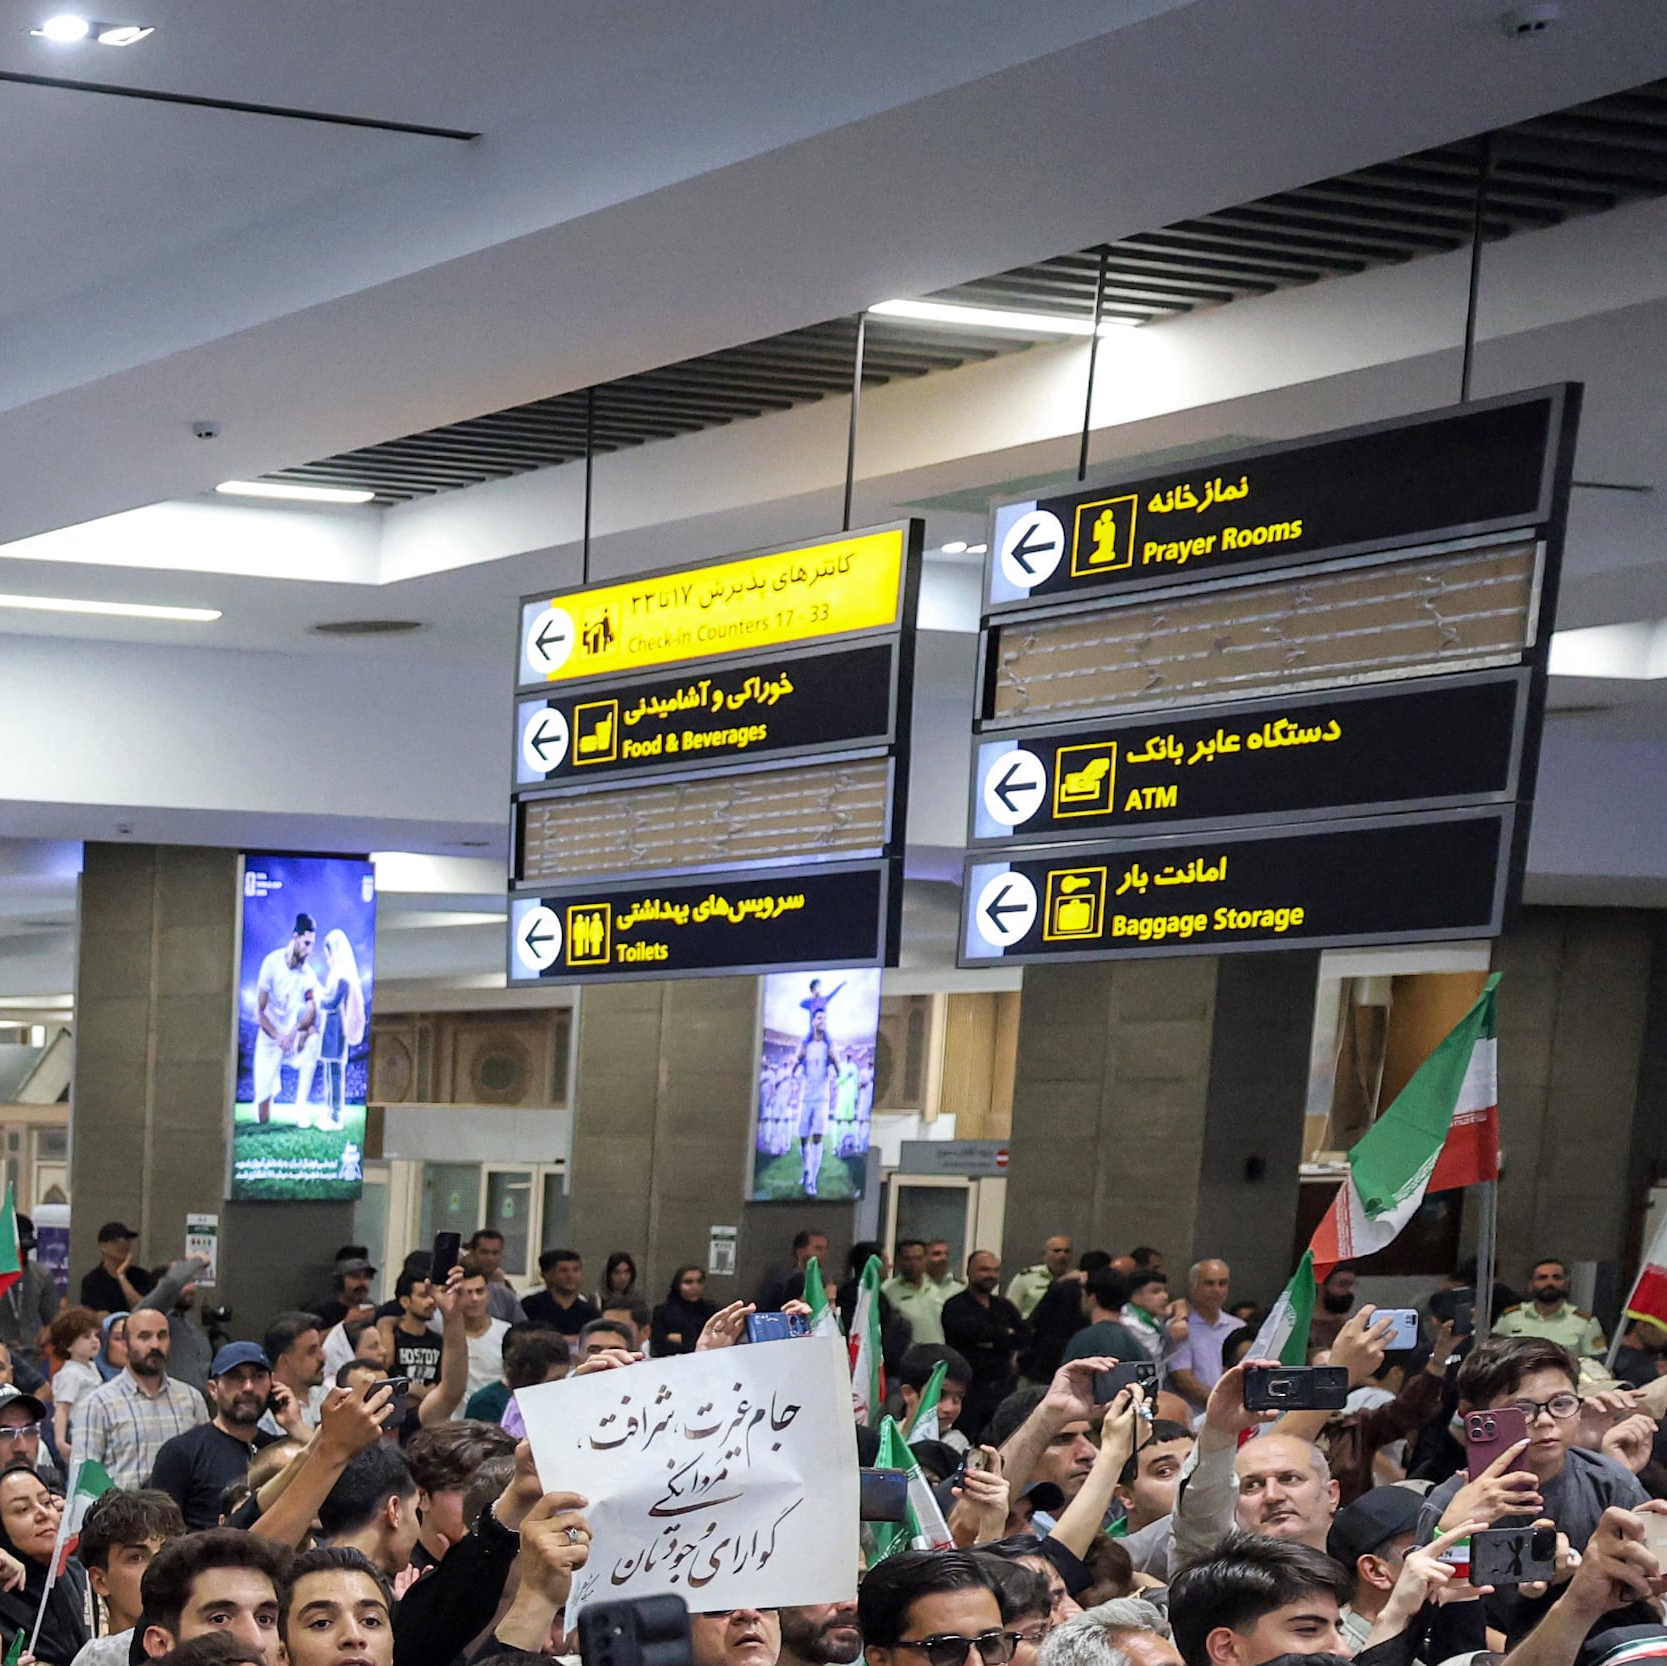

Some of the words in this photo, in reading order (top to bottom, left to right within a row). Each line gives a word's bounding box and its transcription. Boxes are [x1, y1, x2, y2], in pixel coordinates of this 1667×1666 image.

[1147, 475, 1250, 513] نمازخانه
[1142, 534, 1217, 565] Prayer
[1221, 518, 1303, 551] Rooms
[628, 626, 692, 654] Check-in
[697, 618, 769, 643] Counters
[776, 613, 794, 630] 17
[810, 603, 830, 622] 33
[623, 680, 713, 726] آشامیدنی
[711, 687, 724, 713] و
[727, 671, 795, 711] خوراکی
[622, 733, 663, 759] Food
[665, 731, 680, 752] &
[681, 720, 768, 752] Beverages
[1126, 733, 1185, 766] بانک
[1187, 728, 1241, 766] عابر
[1247, 718, 1342, 750] دستگاه
[1124, 785, 1178, 811] ATM
[1115, 864, 1149, 895] بار
[1154, 855, 1228, 886] امانت
[616, 898, 690, 931] بهداشتی
[1111, 912, 1207, 940] Baggage
[1213, 906, 1305, 932] Storage
[615, 941, 669, 963] Toilets
